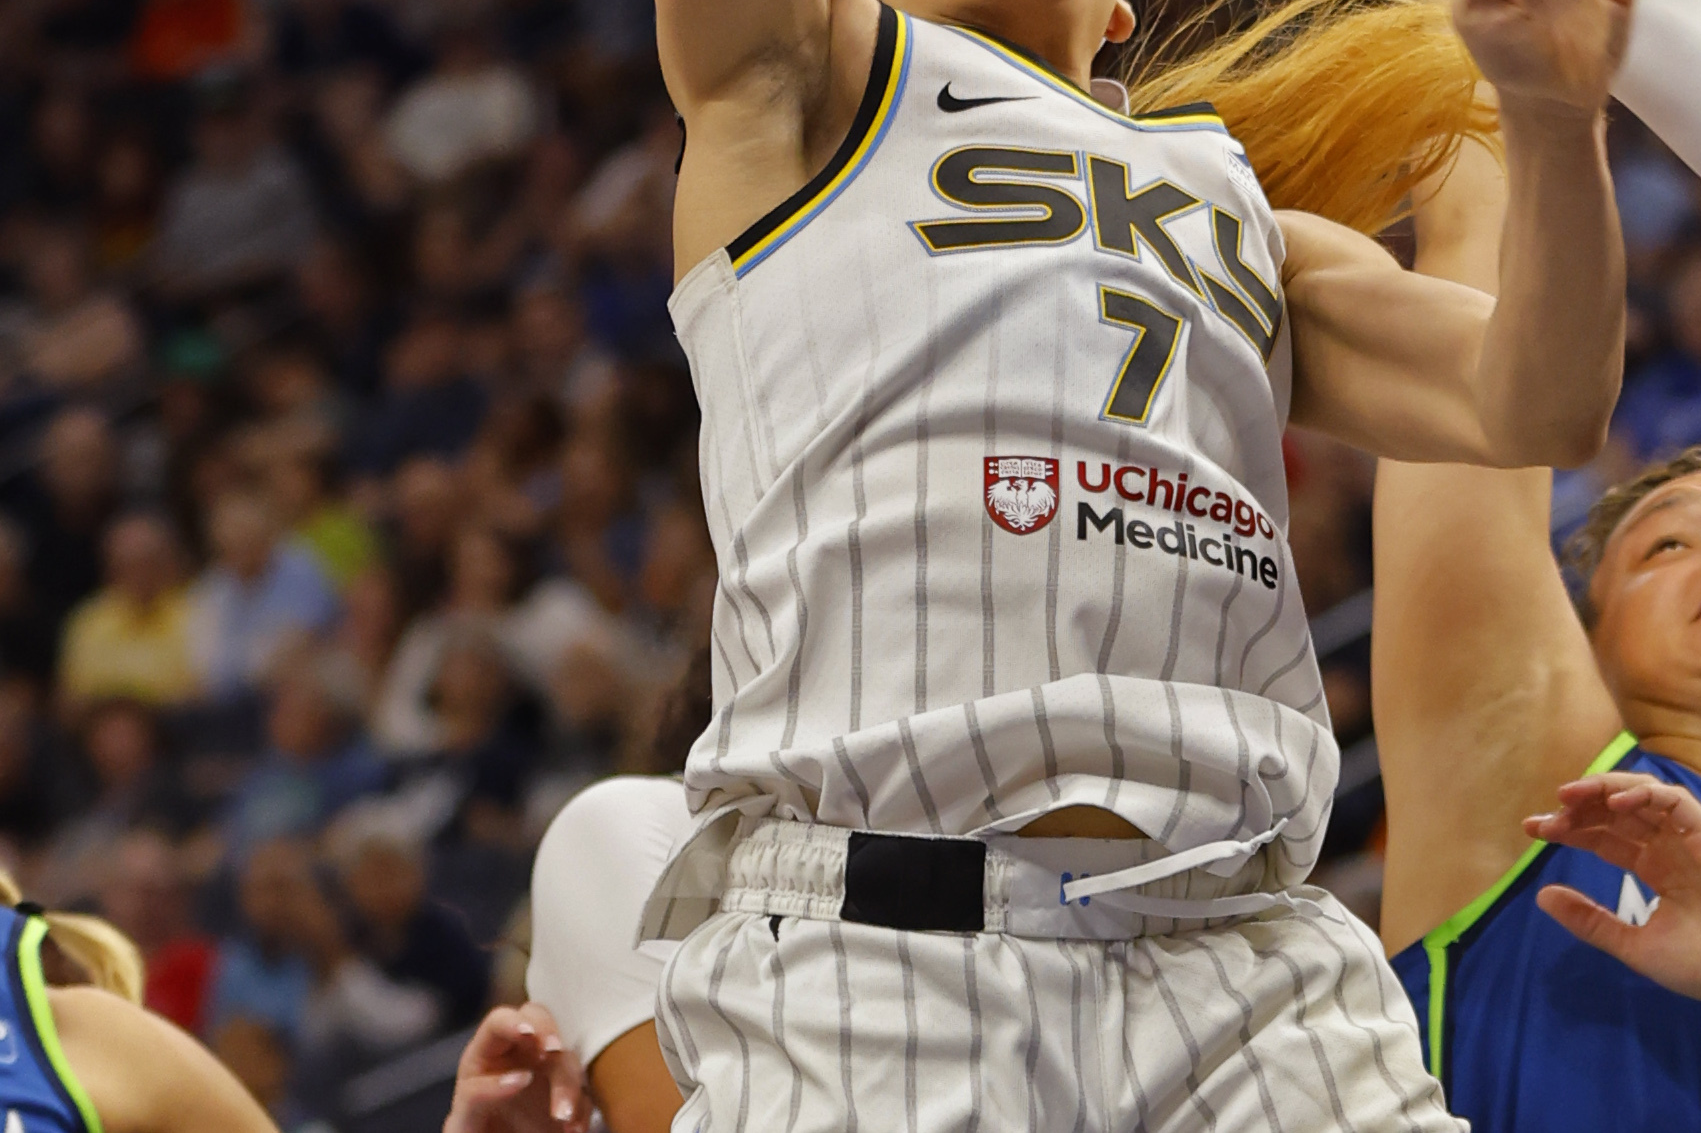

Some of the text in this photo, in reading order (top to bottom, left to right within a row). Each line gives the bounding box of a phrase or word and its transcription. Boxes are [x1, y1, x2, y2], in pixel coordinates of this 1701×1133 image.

[906, 143, 1285, 369] SKY
[1096, 282, 1193, 429] 7
[1077, 460, 1274, 541] UChicago
[1077, 502, 1279, 590] Medicine
